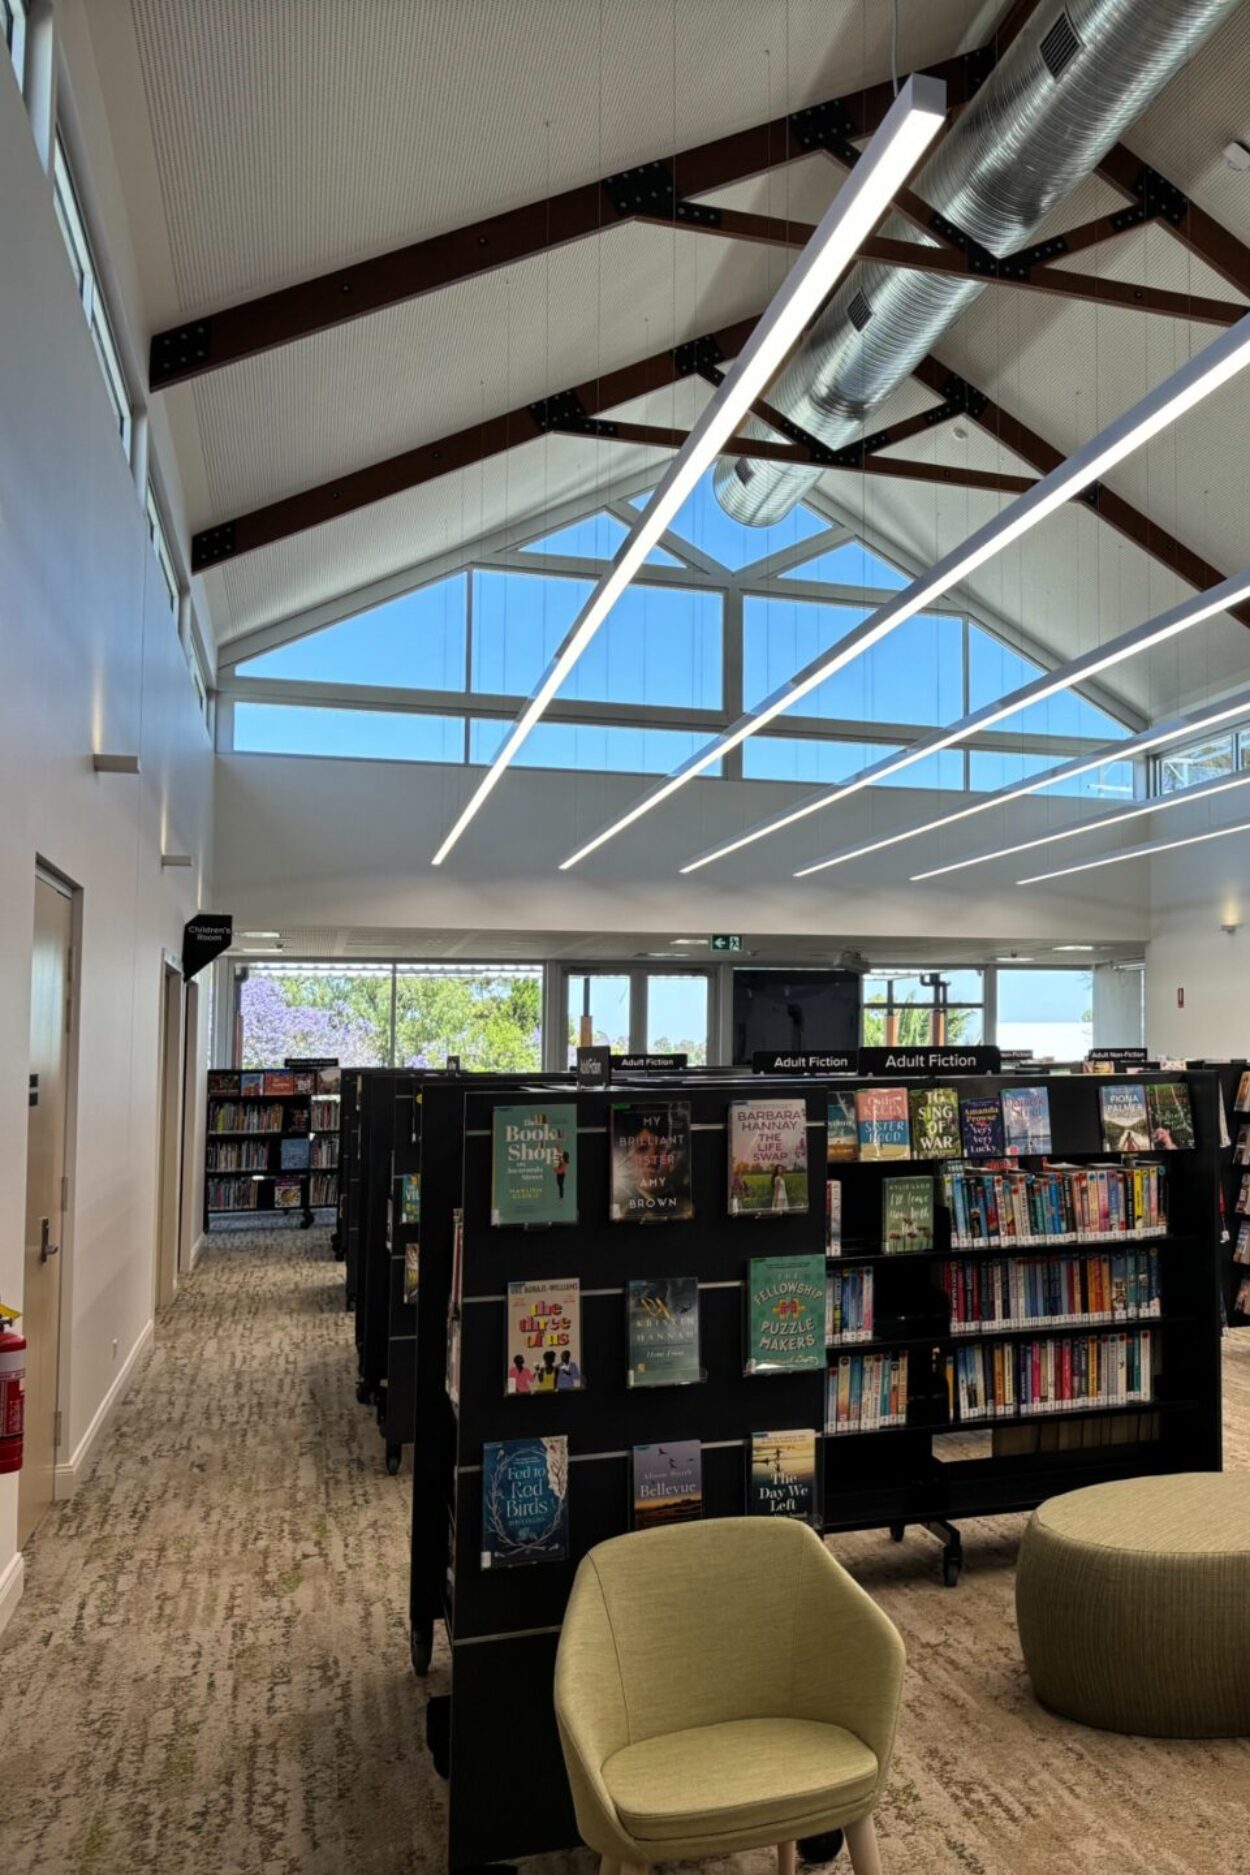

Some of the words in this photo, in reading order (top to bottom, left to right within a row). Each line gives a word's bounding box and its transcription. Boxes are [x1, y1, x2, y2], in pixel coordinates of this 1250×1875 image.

[188, 926, 231, 935] Children's
[621, 1058, 645, 1066] Adult
[646, 1057, 674, 1066] Fiction
[773, 1056, 807, 1068] Adult
[809, 1055, 848, 1067] Fiction
[885, 1054, 927, 1068] Adult
[929, 1053, 976, 1067] Fiction
[1110, 1095, 1138, 1103] FIONA
[918, 1106, 953, 1120] SING
[1106, 1103, 1143, 1111] PALMER
[642, 1116, 661, 1126] MY
[737, 1111, 801, 1121] BARBARA
[741, 1120, 799, 1131] HANNAY
[927, 1121, 945, 1134] OF
[506, 1123, 559, 1142] Book
[758, 1133, 782, 1142] THE
[619, 1134, 684, 1146] BRILLIANT
[920, 1136, 953, 1149] WAR
[507, 1142, 559, 1165] Shop
[757, 1143, 782, 1152] LIFE
[630, 1153, 675, 1166] ISTER
[752, 1152, 788, 1161] SWAP
[640, 1177, 667, 1188] AMY
[628, 1197, 678, 1209] BROWN
[754, 1282, 823, 1305] FELLOWSHIP
[530, 1301, 562, 1317] the
[520, 1316, 571, 1333] three
[761, 1318, 815, 1335] PUZZLE
[544, 1333, 570, 1347] us
[759, 1334, 815, 1351] MAKERS
[507, 1467, 532, 1479] Fed
[533, 1467, 546, 1478] to
[771, 1473, 797, 1487] The
[511, 1481, 543, 1499] Red
[640, 1481, 696, 1498] Bellevue
[759, 1488, 784, 1502] Day
[786, 1485, 808, 1498] We
[507, 1498, 548, 1518] Birds
[769, 1499, 796, 1513] Left
